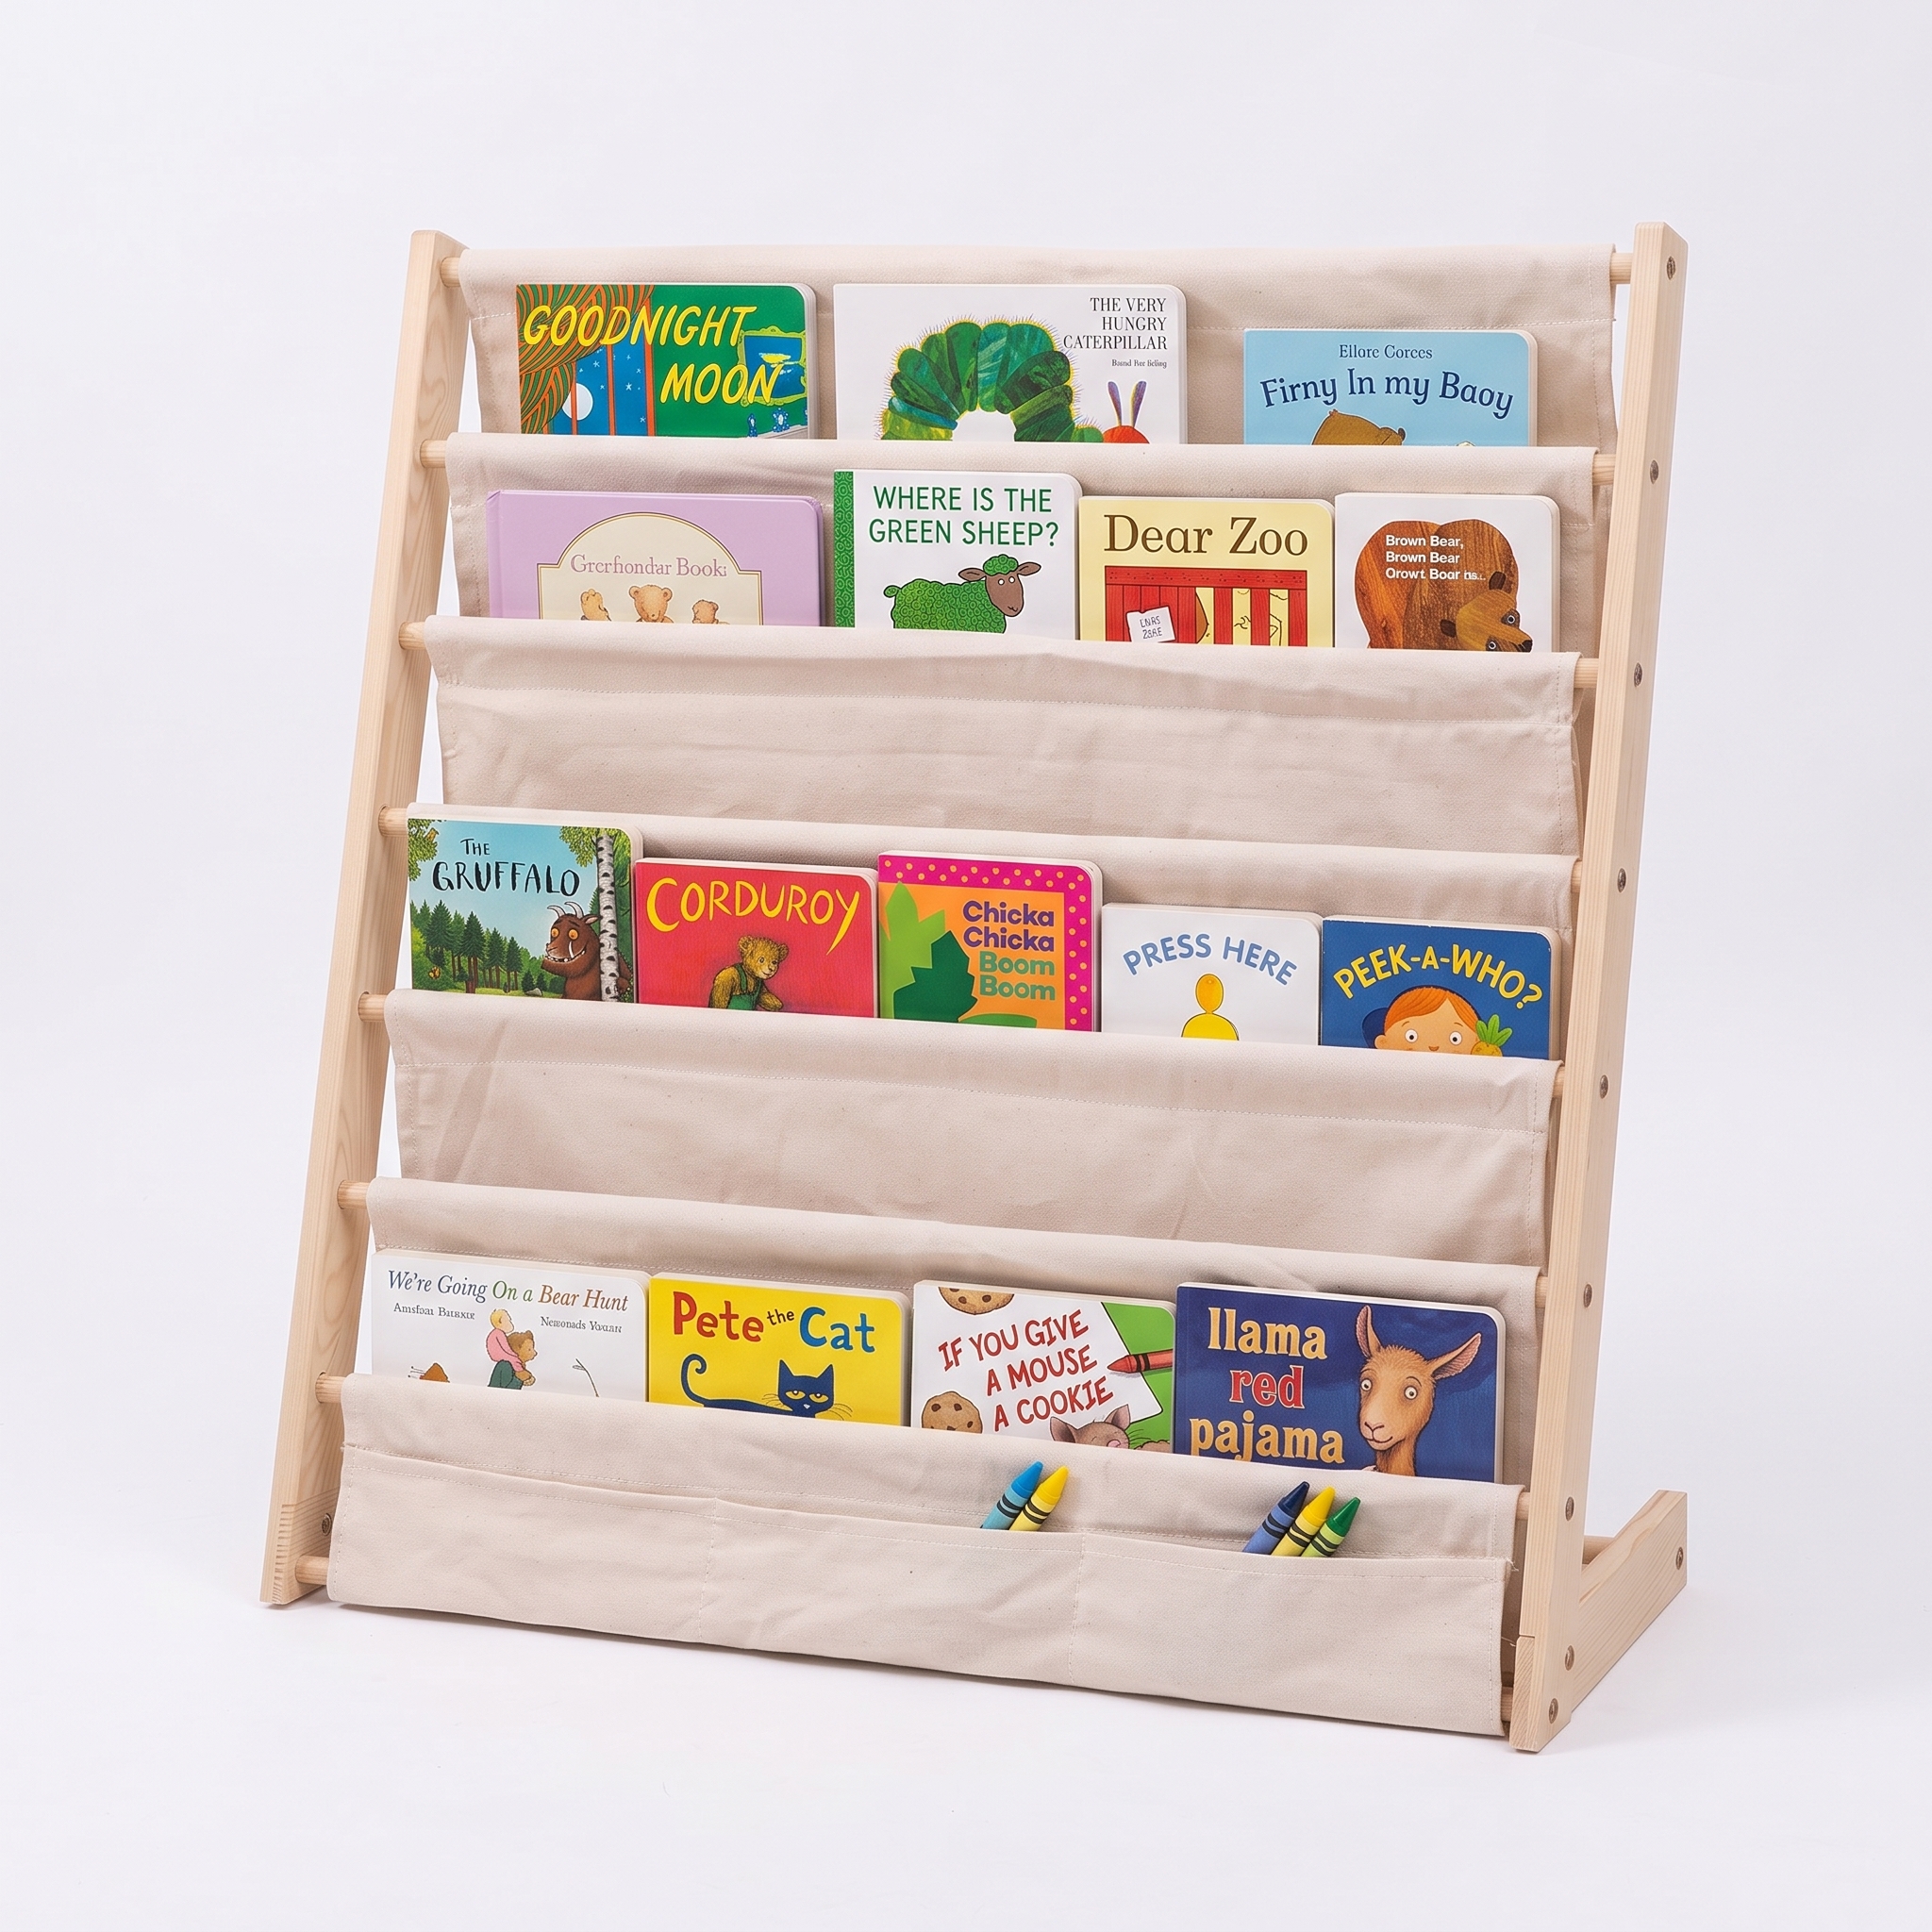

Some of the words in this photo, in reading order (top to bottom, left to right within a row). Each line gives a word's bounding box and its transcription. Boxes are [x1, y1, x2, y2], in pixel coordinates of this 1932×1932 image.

[1090, 297, 1121, 312] THE
[1125, 297, 1167, 312] VERY
[1102, 316, 1167, 331] HUNGRY
[523, 305, 758, 347] GOODNIGHT
[1063, 334, 1168, 350] CATERPILLAR
[659, 362, 783, 405] MOON
[1259, 377, 1338, 408] Firny
[1347, 367, 1376, 395] In
[1384, 375, 1429, 406] my
[1439, 371, 1514, 420] Baoy
[873, 485, 962, 511] WHERE
[973, 487, 995, 512] IS
[1004, 487, 1053, 513] THE
[869, 518, 952, 544] GREEN
[962, 520, 1059, 547] SHEEP?
[1103, 514, 1213, 555] Dear
[1228, 516, 1308, 556] Zoo
[1385, 534, 1426, 546] Brown
[1429, 535, 1464, 549] Bear,
[1385, 551, 1426, 563] Brown
[1429, 552, 1460, 564] Bear
[460, 838, 491, 857] THE
[431, 860, 581, 898] GRUFFALO
[645, 876, 860, 956] CORDUROY
[962, 900, 1055, 927] Chicka
[962, 925, 1055, 953] Chicka
[1122, 932, 1213, 976] PRESS
[1221, 935, 1299, 987] HERE
[978, 950, 1055, 976] Boom
[1332, 942, 1544, 1010] PEEK-A-WHO?
[978, 974, 1056, 1001] Boom
[388, 1270, 432, 1292] We're
[437, 1274, 488, 1303] Going
[491, 1279, 519, 1301] On
[522, 1289, 534, 1303] a
[538, 1284, 580, 1307] Bear
[582, 1289, 629, 1311] Hunt
[673, 1291, 764, 1342] Pete
[766, 1307, 795, 1326] the
[799, 1306, 875, 1353] Cat
[938, 1337, 963, 1372] IF
[968, 1323, 1019, 1361] YOU
[1024, 1308, 1090, 1347] GIVE
[1208, 1306, 1328, 1360] llama
[986, 1368, 1002, 1396] A
[1007, 1344, 1097, 1391] MOUSE
[1228, 1364, 1306, 1409] red
[993, 1403, 1009, 1432] A
[1016, 1375, 1114, 1425] COOKIE
[1189, 1409, 1345, 1464] pajama
